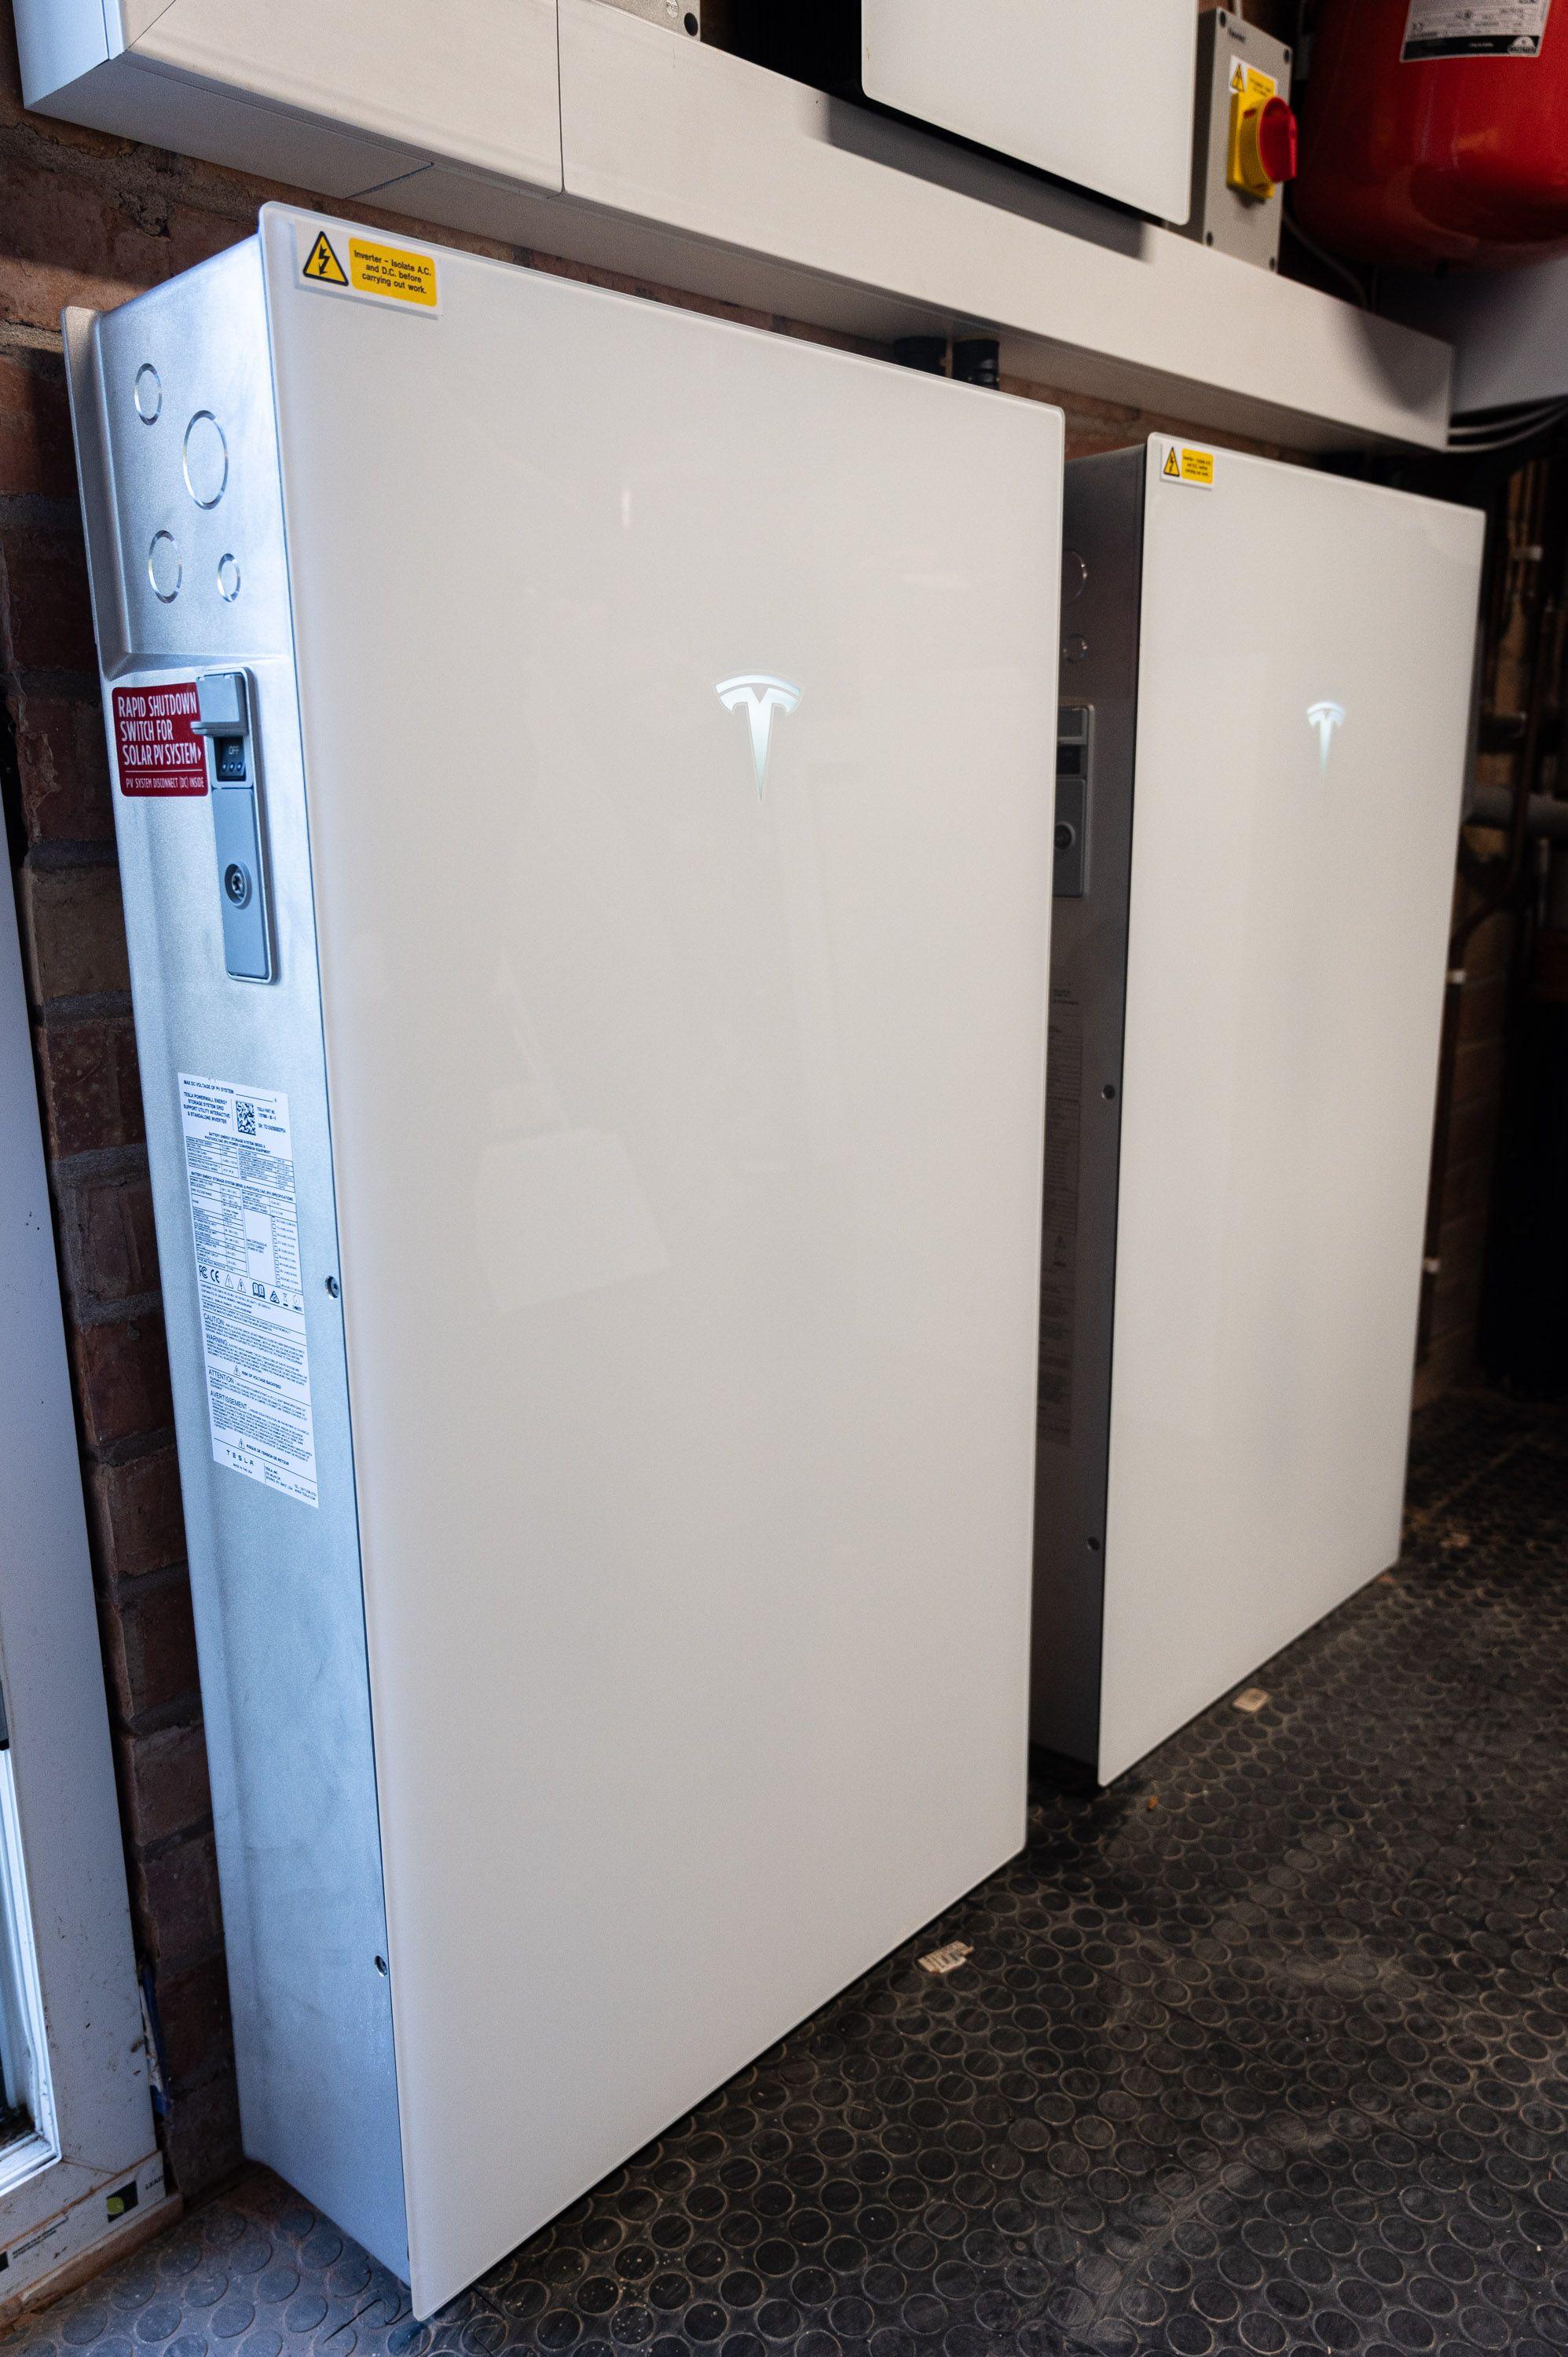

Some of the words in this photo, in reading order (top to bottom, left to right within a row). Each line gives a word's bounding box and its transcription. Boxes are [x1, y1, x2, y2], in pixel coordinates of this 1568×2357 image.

[354, 250, 382, 263] Inverter
[391, 259, 415, 272] Isolate
[418, 266, 430, 276] A.C.
[366, 263, 379, 273] and
[383, 267, 396, 277] D.C.
[399, 272, 422, 283] before
[362, 273, 391, 287] carrying
[408, 284, 427, 294] work.
[118, 697, 146, 717] RAPID
[148, 692, 197, 717] SHUTDOWN
[120, 720, 155, 742] SWITCH
[156, 720, 173, 741] FOR
[123, 745, 152, 766] SOLAR
[155, 745, 163, 764] PV
[166, 742, 197, 764] SYSTEM
[229, 746, 240, 755] OFF
[126, 779, 133, 788] PV
[135, 779, 152, 788] SYSTEM
[153, 778, 178, 788] DISCONNECT
[179, 778, 189, 789] (DC)
[190, 777, 204, 787] INSIDE
[208, 1369, 234, 1384] ATTENTION
[211, 1390, 247, 1411] AVERTISSEMENT
[226, 1450, 254, 1467] TESLA
